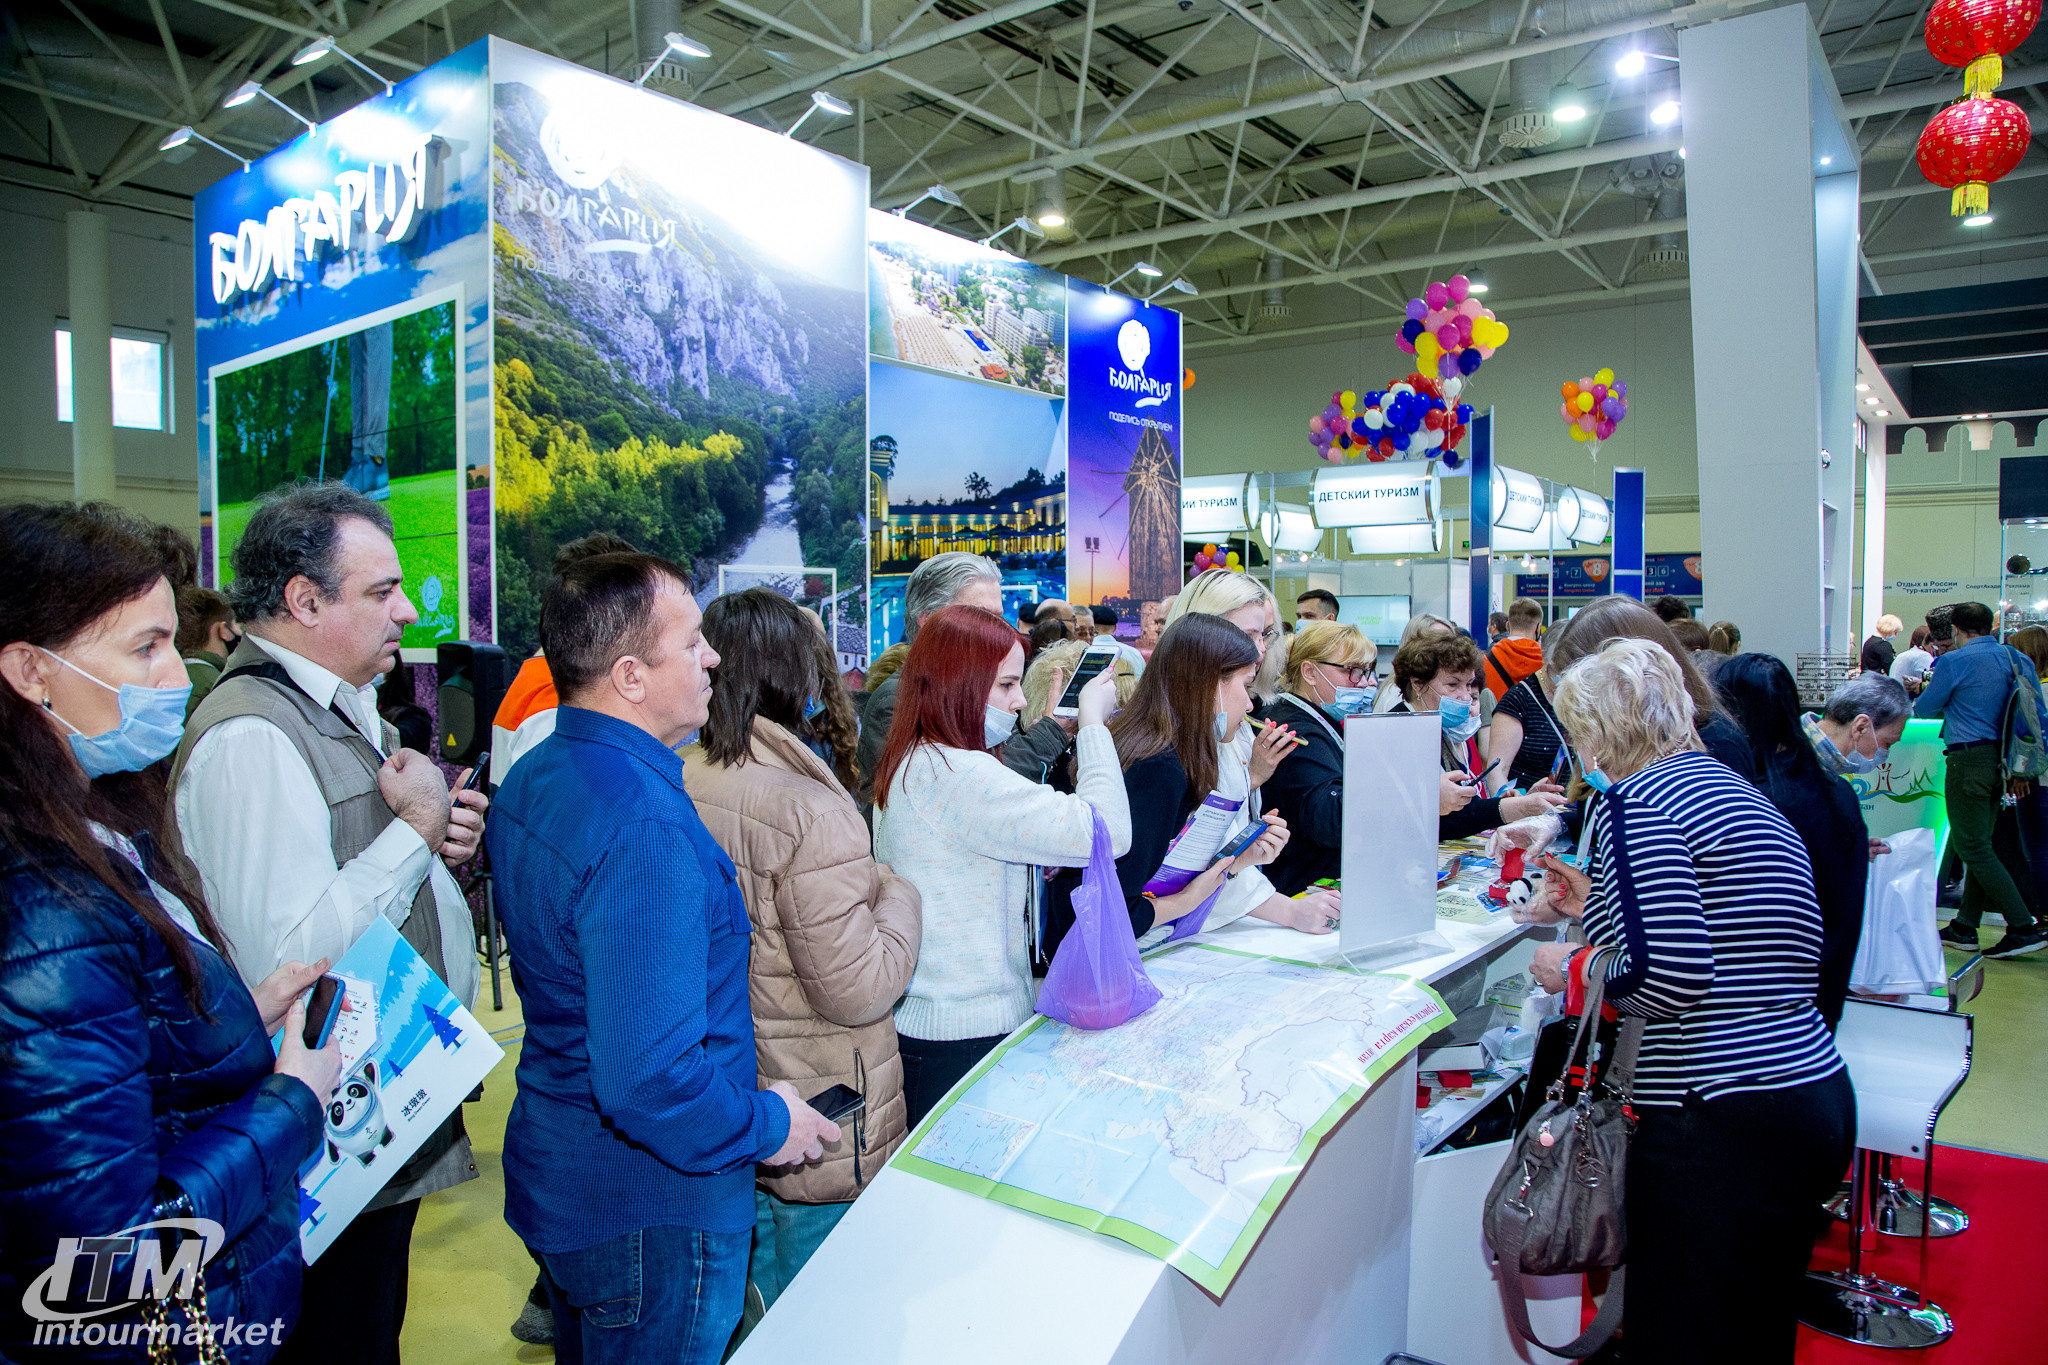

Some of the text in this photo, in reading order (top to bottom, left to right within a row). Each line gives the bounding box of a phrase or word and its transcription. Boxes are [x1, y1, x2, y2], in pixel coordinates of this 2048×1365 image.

[209, 132, 432, 304] БОЛГАРИЯ
[516, 179, 678, 248] БОЛГАРИЯ
[1109, 367, 1172, 401] БОЛГАРИЯ
[1109, 411, 1140, 426] ПОДЕЛИСЬ
[1319, 486, 1420, 503] ДЕТСКИЙ ТУРИЗМ
[1199, 497, 1238, 508] ТУРИЗМ
[1592, 562, 1602, 576] 8
[1896, 580, 1922, 588] Отдых
[1929, 580, 1959, 588] России
[1902, 586, 1954, 595] "тур-каталог"
